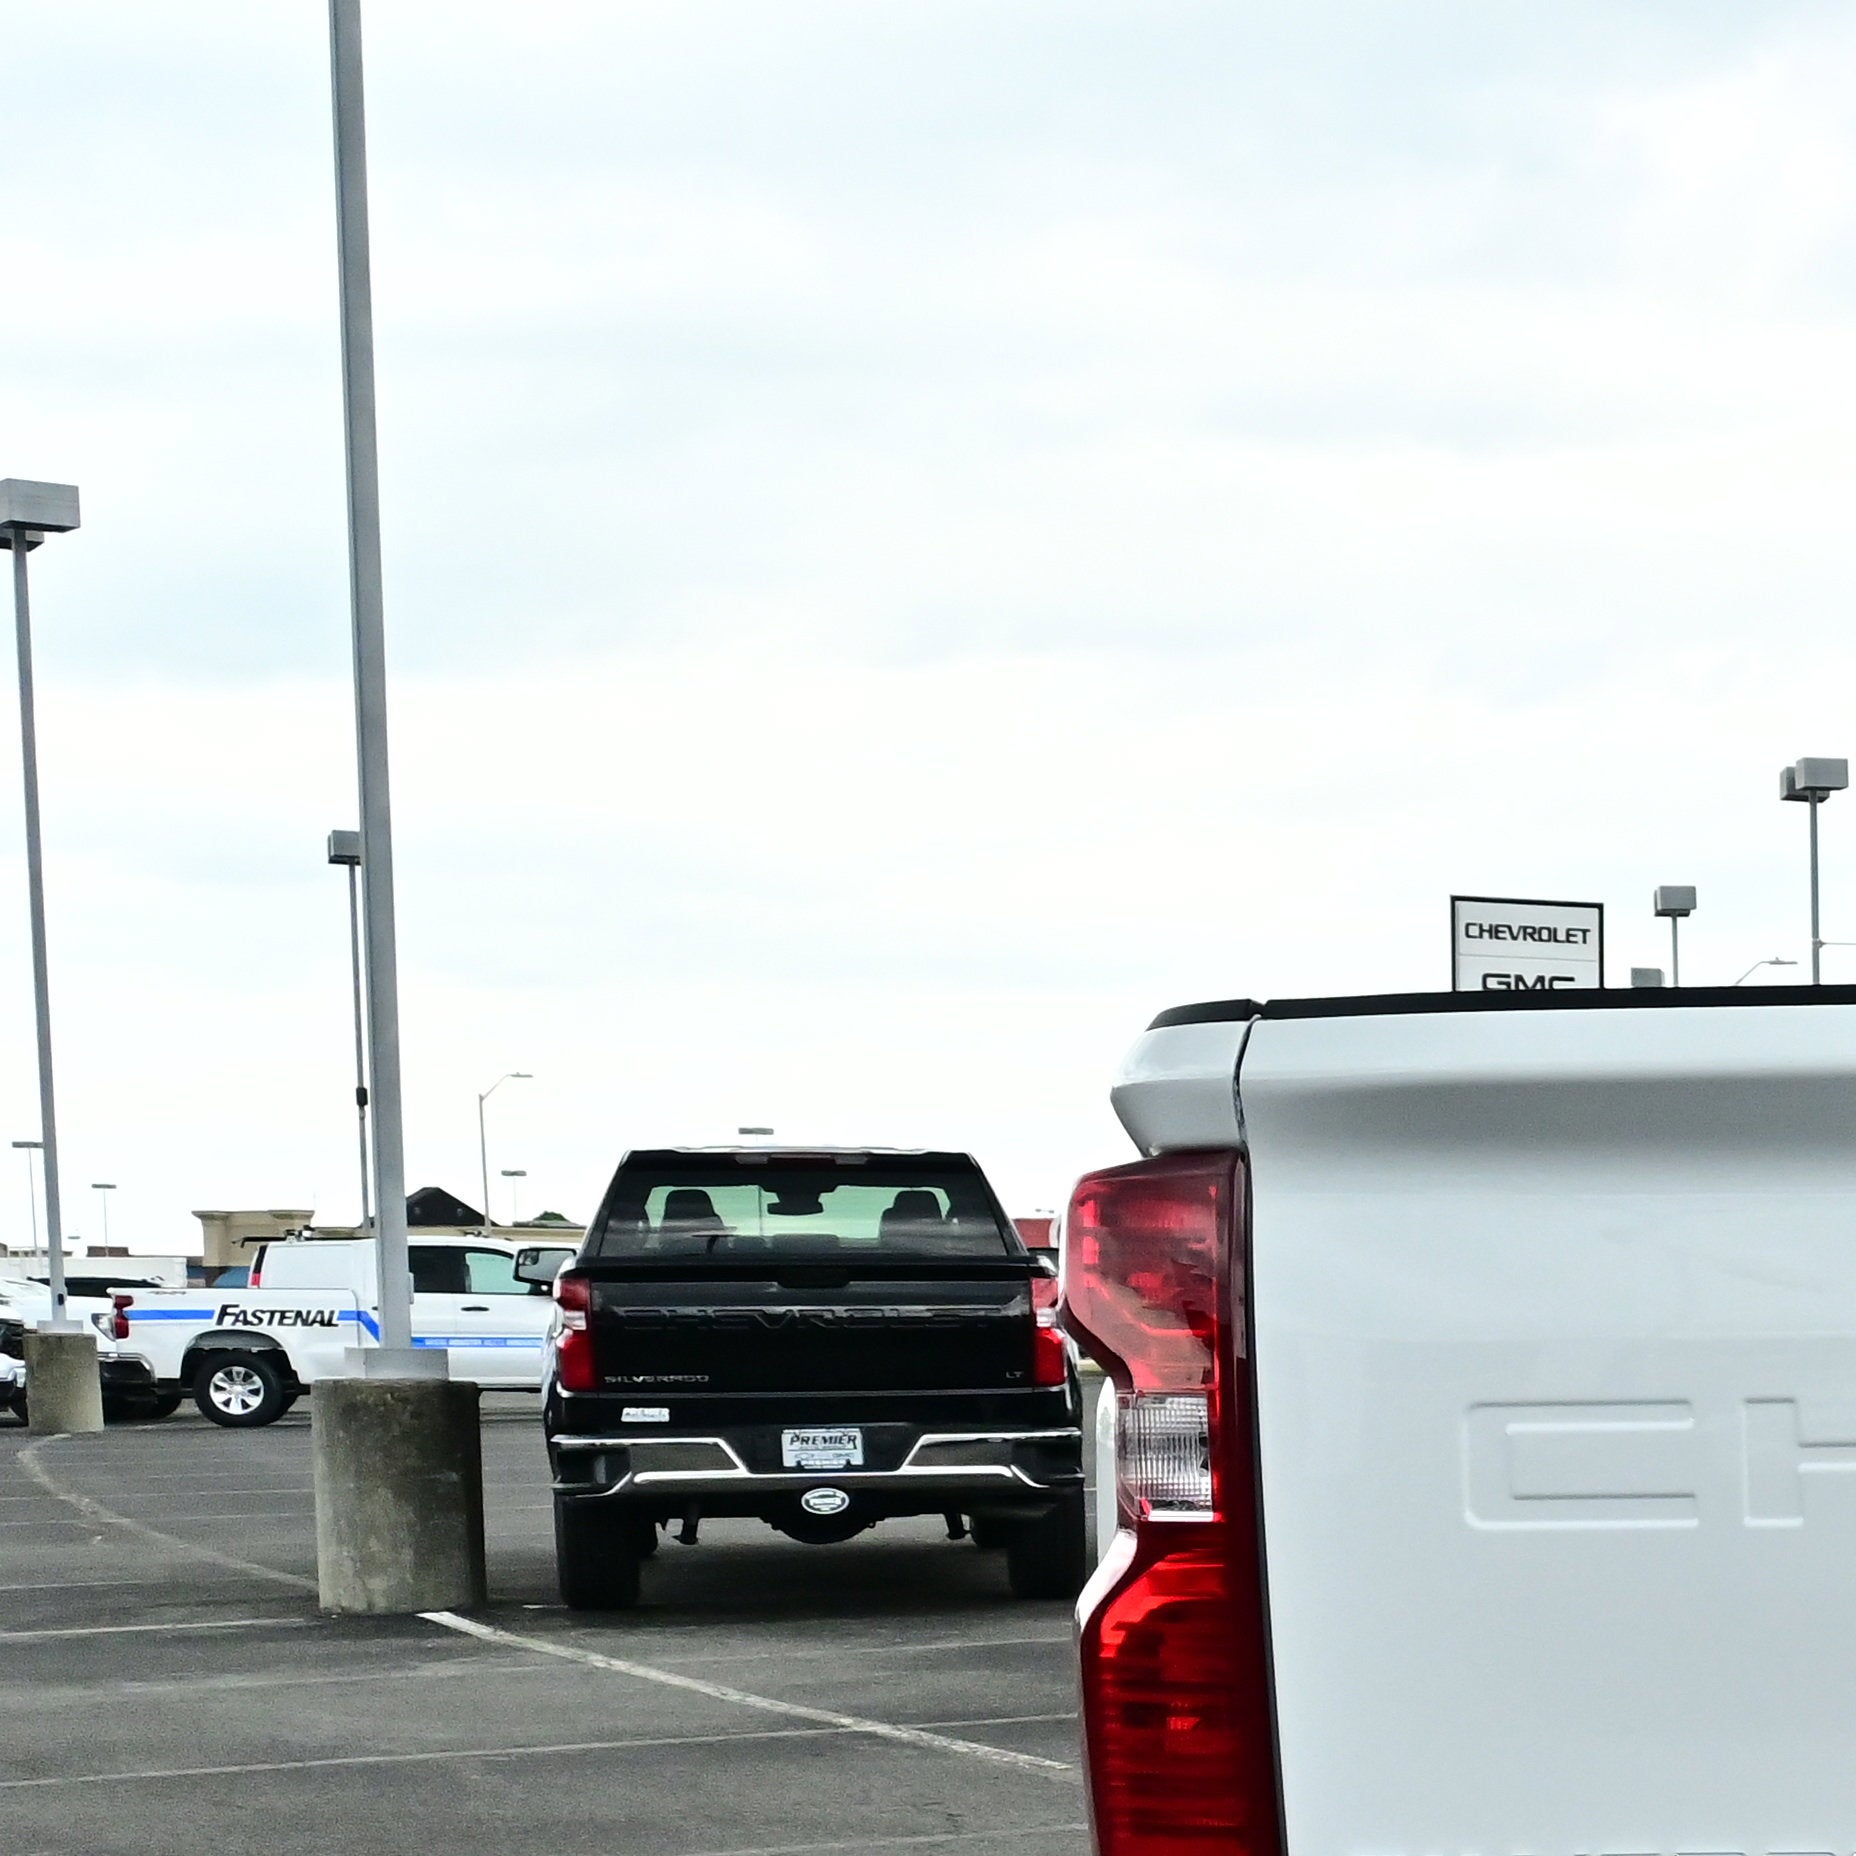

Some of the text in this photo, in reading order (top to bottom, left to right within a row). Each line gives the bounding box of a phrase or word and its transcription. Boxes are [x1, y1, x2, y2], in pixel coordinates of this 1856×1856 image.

[1464, 922, 1591, 945] CHEVROLET
[1482, 972, 1576, 991] GMC
[789, 1434, 857, 1448] PREMIER
